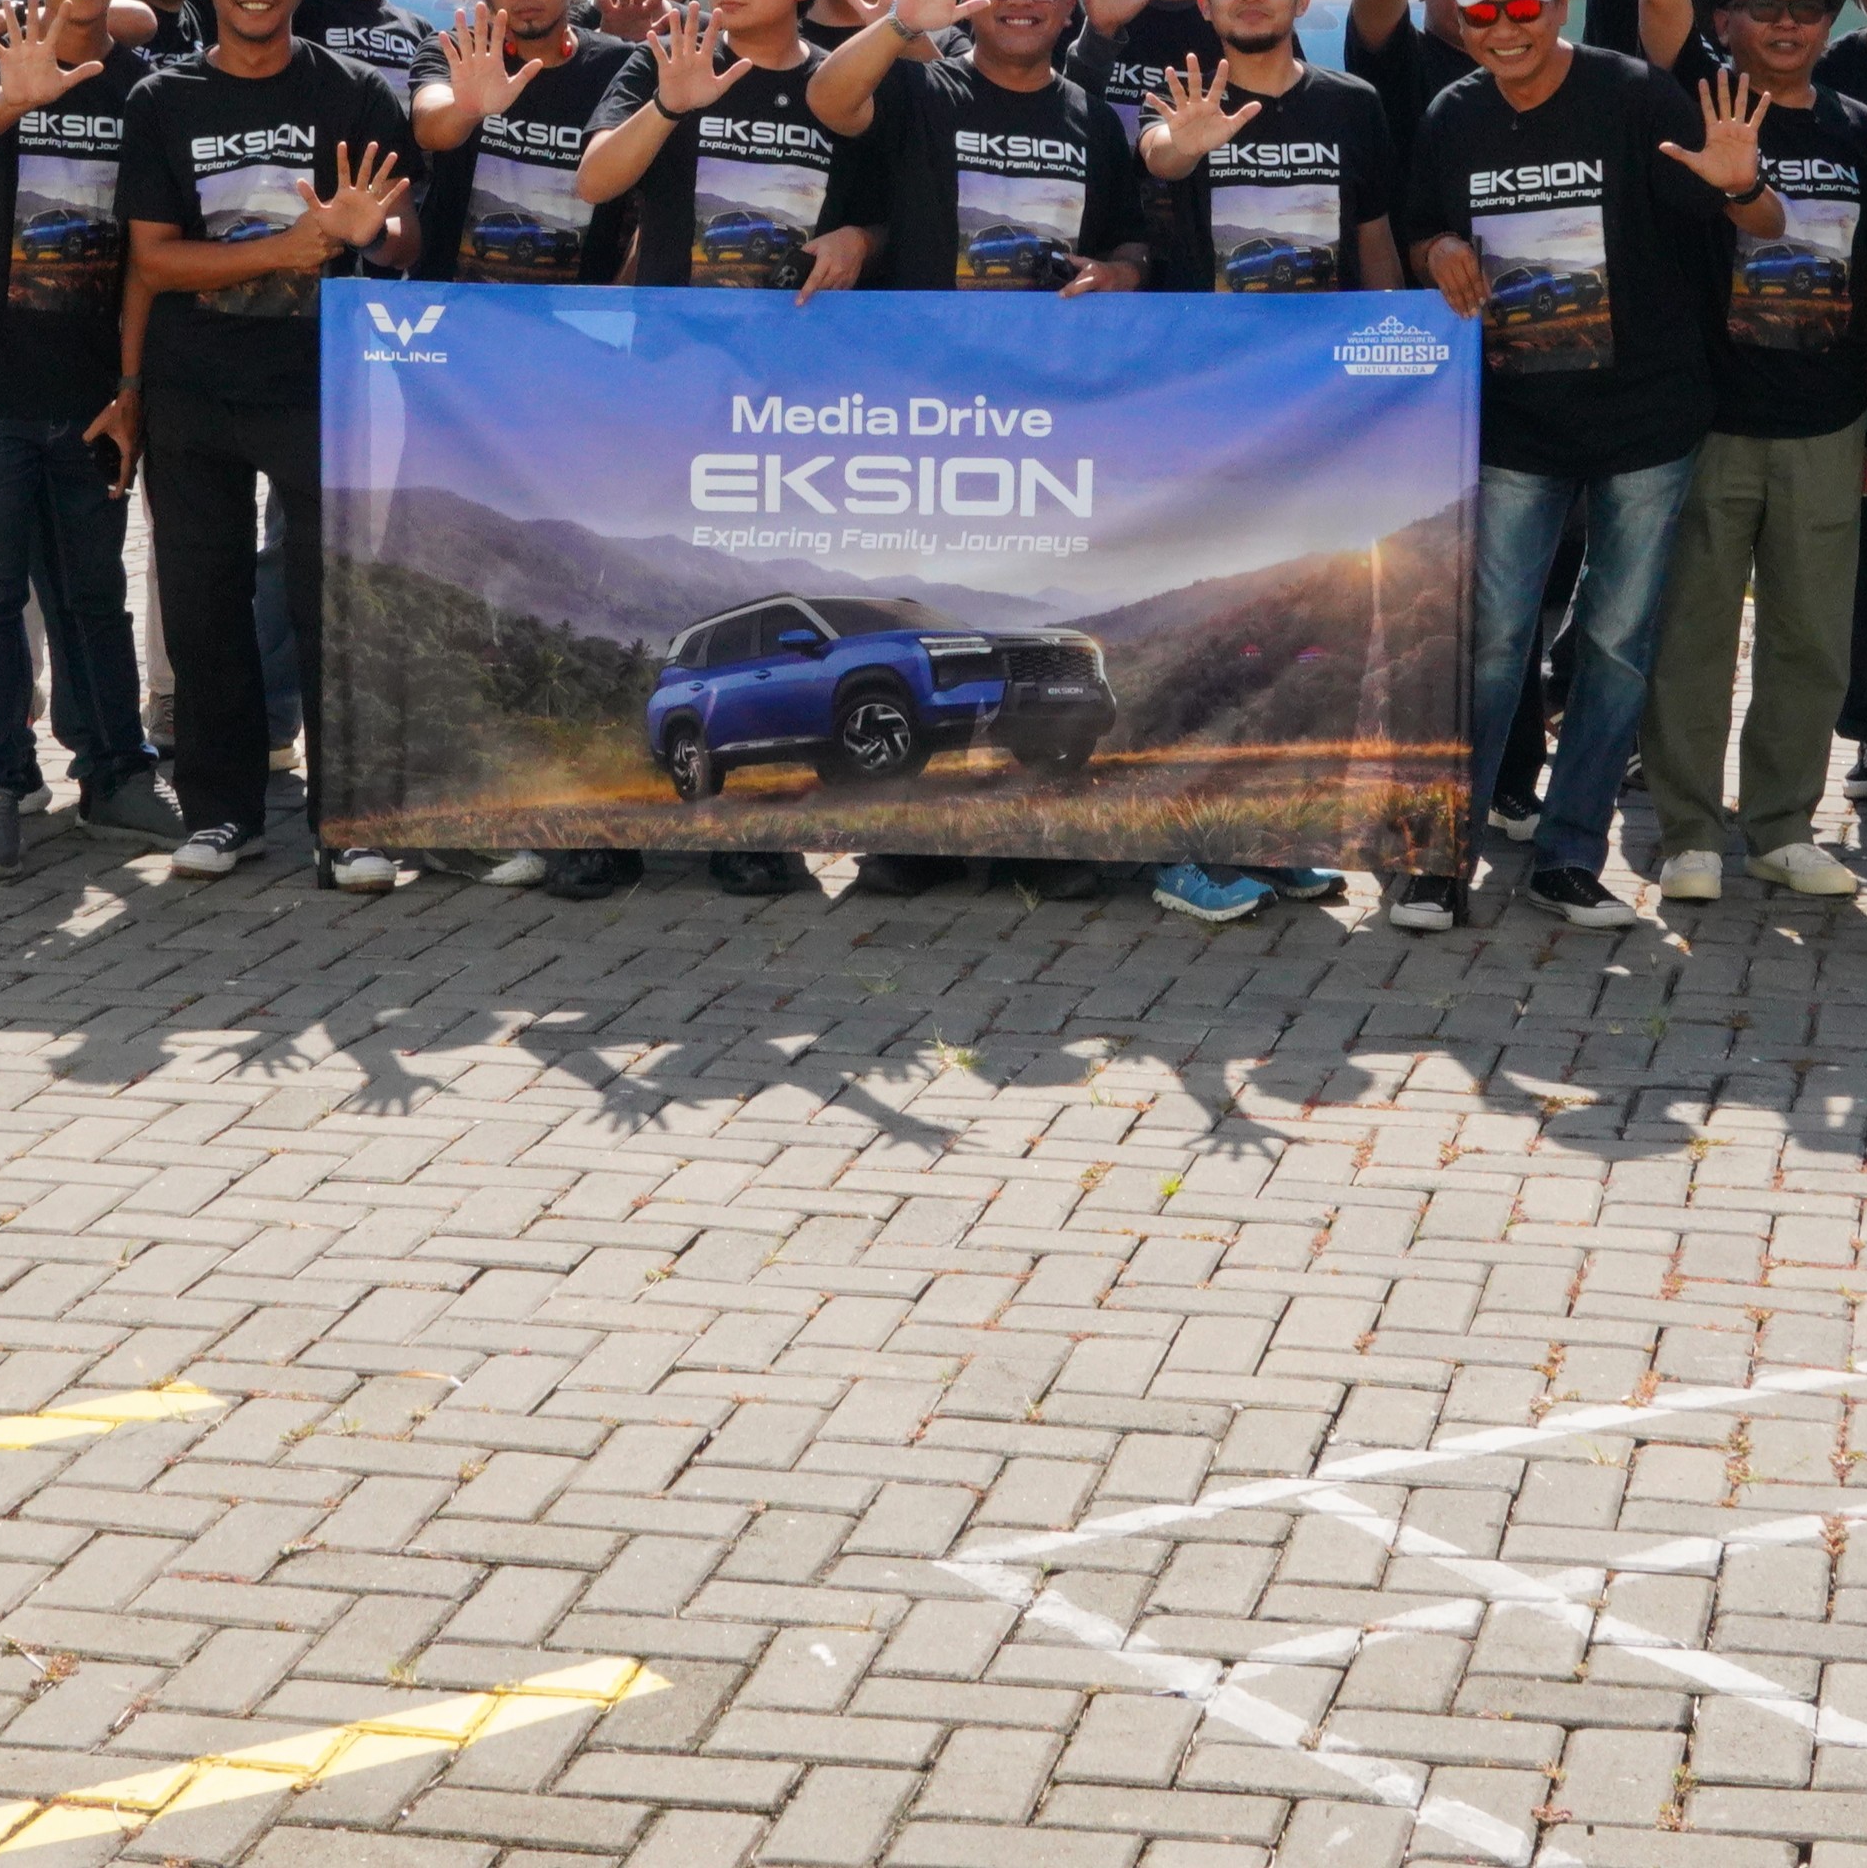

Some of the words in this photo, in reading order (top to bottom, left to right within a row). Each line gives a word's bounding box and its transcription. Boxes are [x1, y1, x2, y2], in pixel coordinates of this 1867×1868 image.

[1105, 85, 1142, 98] ploring
[192, 123, 315, 160] EKSION
[483, 114, 582, 149] EKSIO
[699, 116, 833, 154] EKSION
[62, 139, 95, 151] Family
[96, 142, 120, 150] Jour
[272, 149, 314, 162] Journeys
[523, 145, 556, 160] Family
[557, 152, 582, 162] Jour
[698, 139, 747, 156] Exploring
[749, 145, 783, 158] Family
[785, 149, 831, 164] Journeys
[955, 131, 1087, 165] EKSION
[1209, 142, 1340, 166] EKSION
[957, 153, 1004, 169] Exploring
[1006, 160, 1040, 170] Family
[1042, 163, 1085, 177] Journeys
[1209, 167, 1256, 178] Exploring
[1258, 167, 1291, 179] Family
[1293, 167, 1340, 178] Journeys
[1469, 159, 1602, 195] EKSION
[1757, 148, 1859, 184] SION
[1470, 195, 1516, 208] Exploring
[1517, 192, 1552, 203] Family
[1553, 187, 1602, 200] Journeys
[364, 350, 447, 363] WULING
[1356, 365, 1391, 374] UNTUK
[1396, 365, 1426, 374] ANDA
[732, 393, 898, 435] Media
[909, 395, 1053, 437] Drive
[690, 453, 1093, 518] EKSION
[692, 525, 832, 555] Exploring
[841, 528, 938, 556] Family
[946, 530, 1089, 557] Journeys
